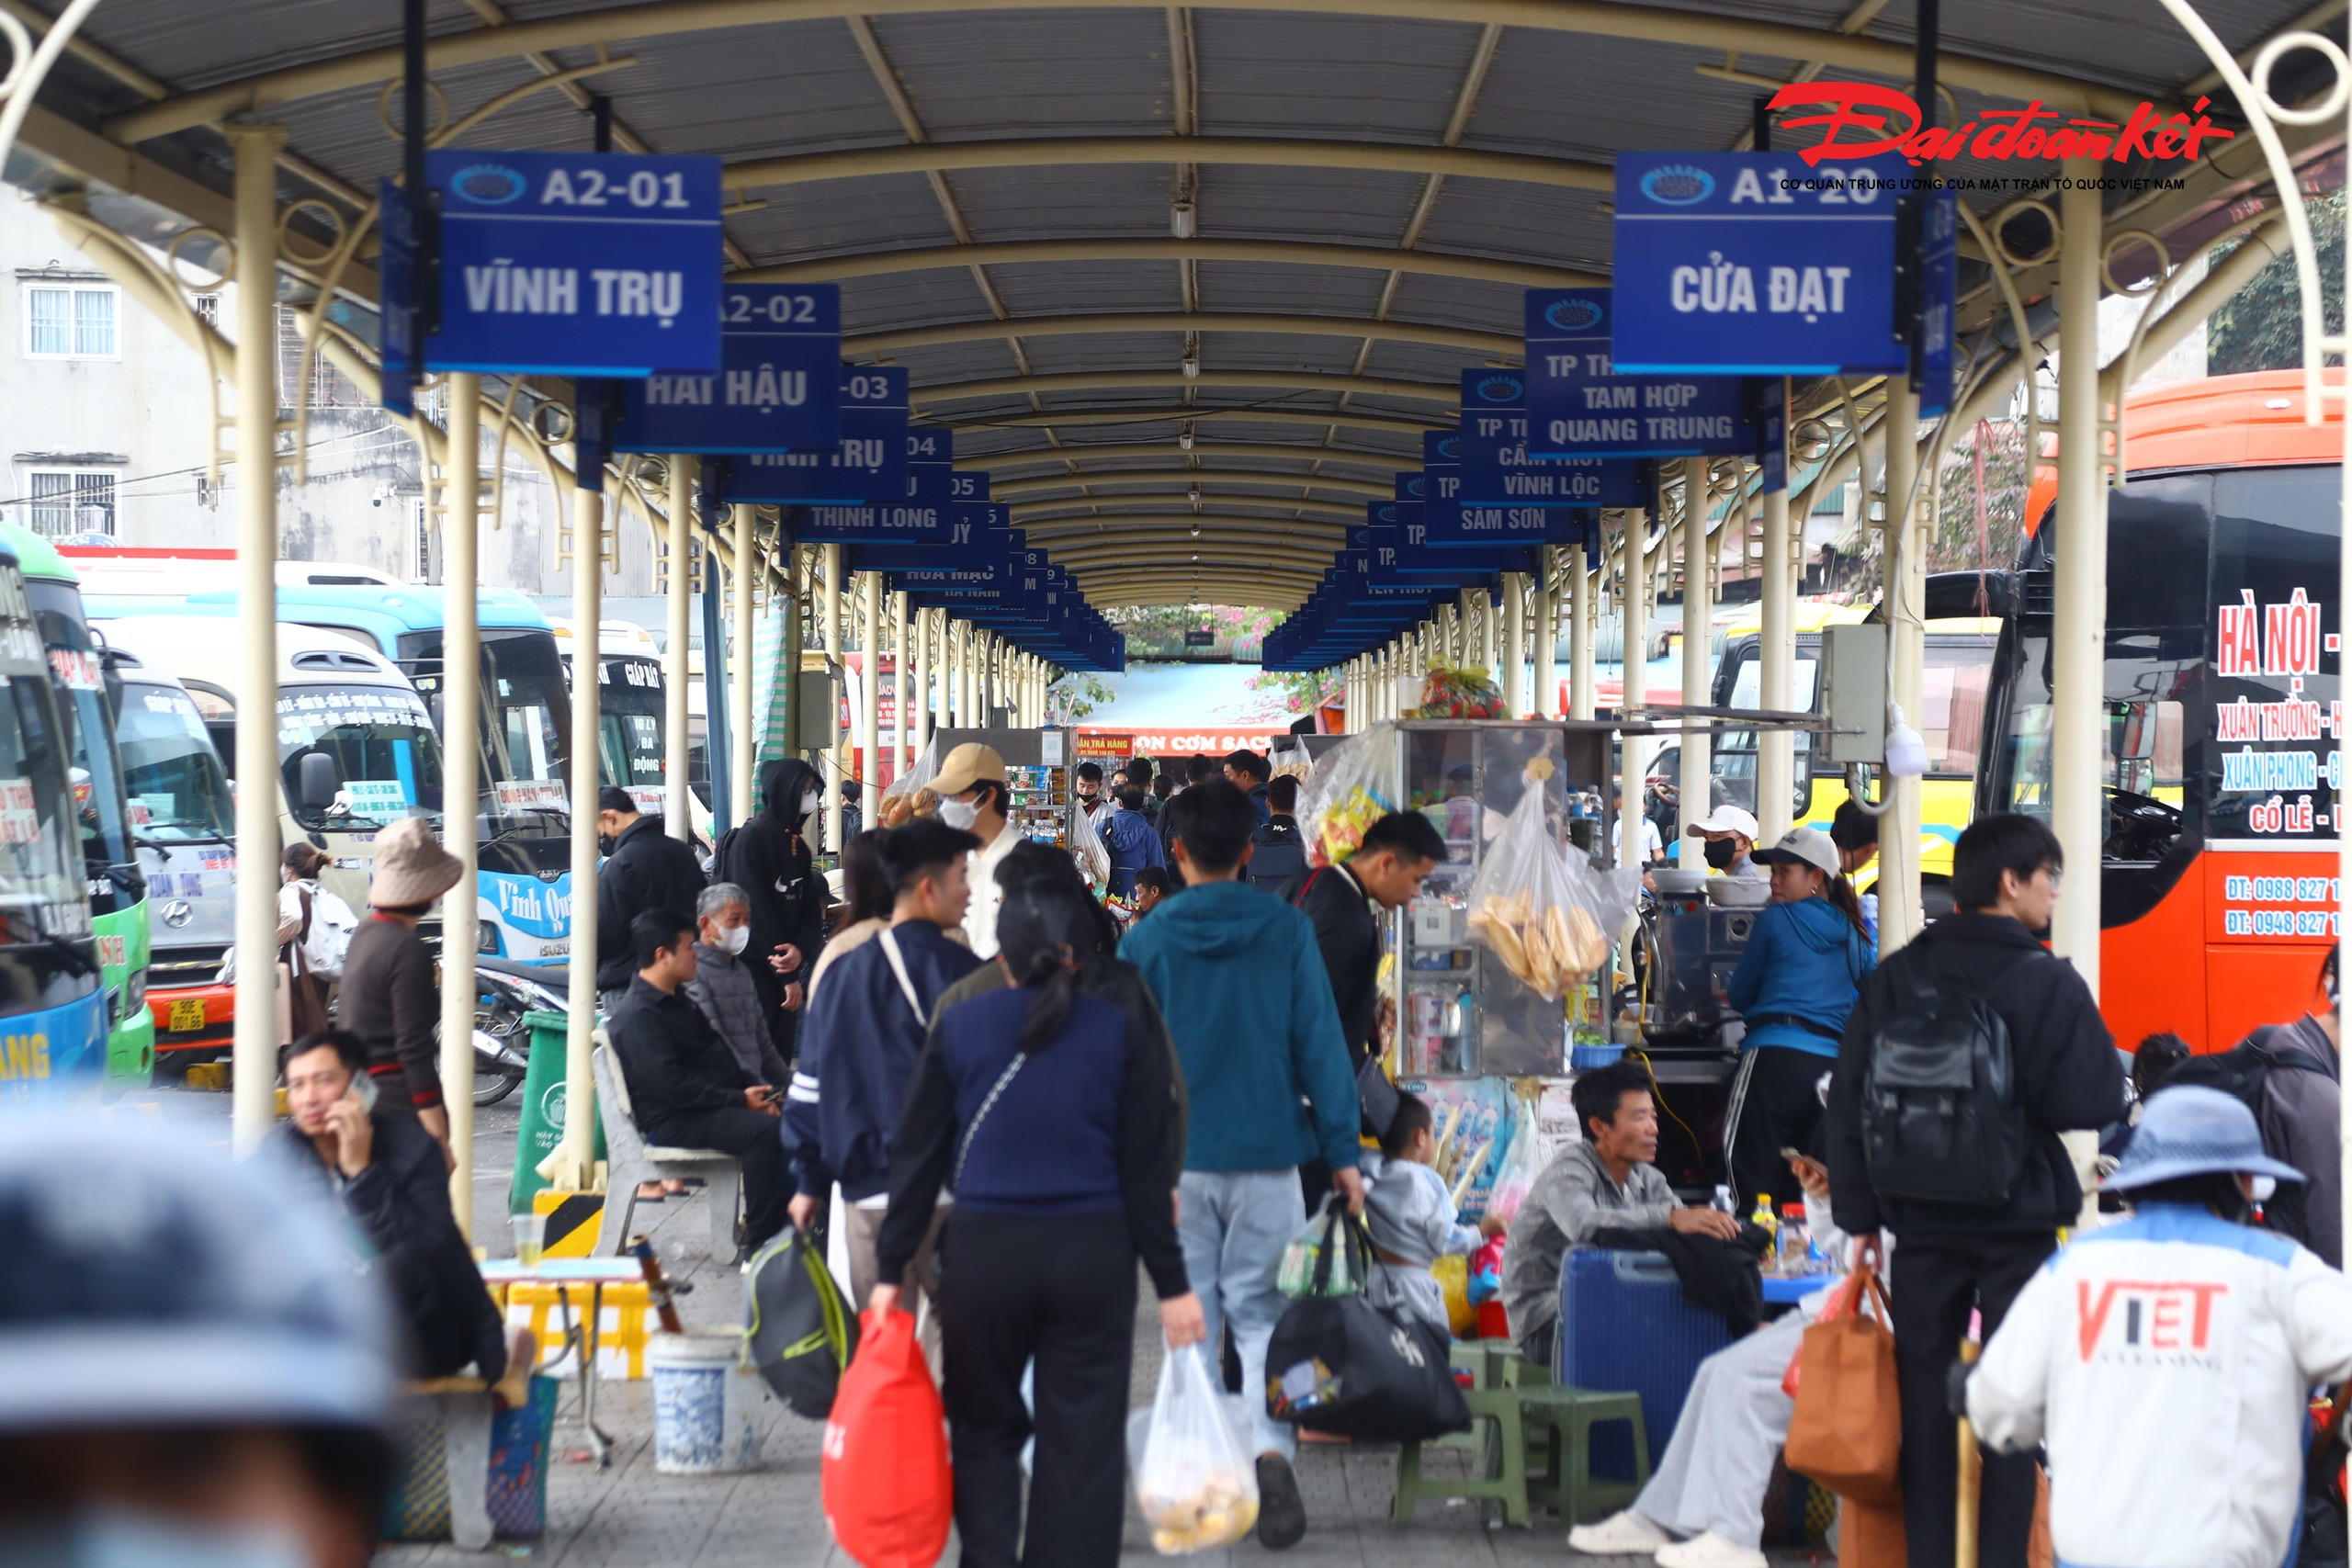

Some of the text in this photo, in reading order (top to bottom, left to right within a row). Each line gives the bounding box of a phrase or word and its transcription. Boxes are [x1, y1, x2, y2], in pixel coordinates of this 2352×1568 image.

[541, 169, 689, 208] A2-01
[1730, 168, 1878, 204] A1-20
[465, 258, 683, 328] VĨNH TRỤ
[1671, 251, 1851, 323] CỬA ĐẠT
[1546, 355, 1577, 377] TP
[727, 363, 807, 413] HẬU
[840, 376, 888, 400] -03
[1583, 383, 1698, 412] TAM HỢP
[1478, 419, 1502, 436] TP
[1549, 418, 1638, 445] QUANG
[1646, 416, 1733, 441] TRUNG
[1438, 478, 1460, 498] TP
[1504, 472, 1600, 499] VĨNH LỘC
[811, 507, 937, 530] THỊNH LONG
[1508, 507, 1545, 529] SƠN
[2218, 589, 2260, 676] HÀ
[2265, 587, 2321, 693] NỘI
[2217, 695, 2260, 741] XUÂN
[2260, 693, 2321, 740] TRƯỜNG
[2222, 745, 2265, 791] XUÂN
[2265, 751, 2317, 791] PHONG
[2251, 795, 2282, 832] CỔ
[2285, 795, 2313, 832] LỄ
[2226, 875, 2329, 901] ĐT: 0988 827
[2226, 910, 2329, 936] ĐT: 0948 827
